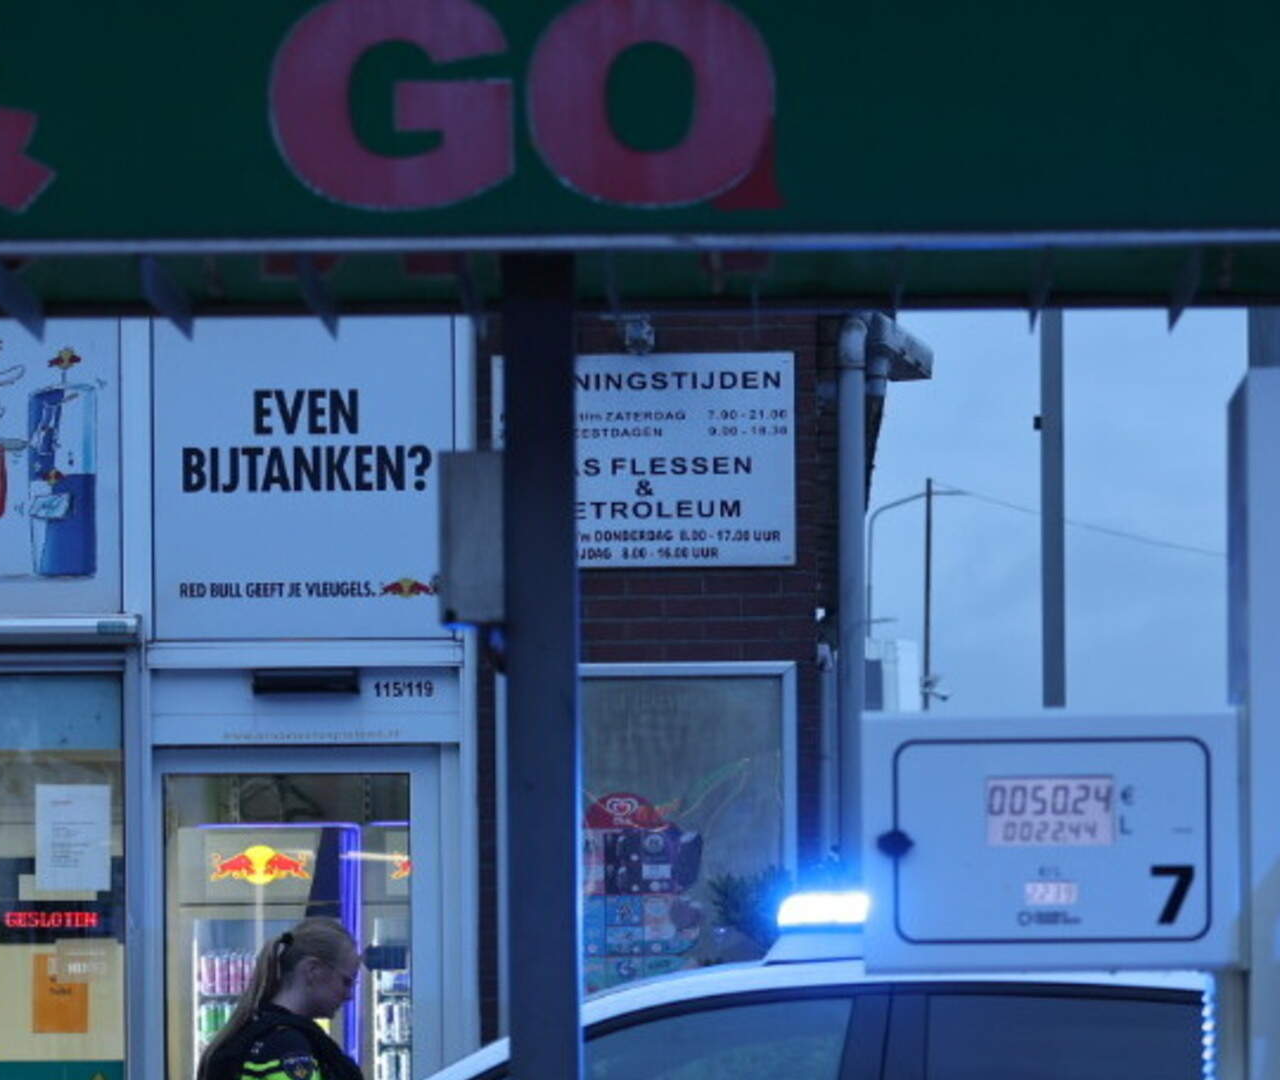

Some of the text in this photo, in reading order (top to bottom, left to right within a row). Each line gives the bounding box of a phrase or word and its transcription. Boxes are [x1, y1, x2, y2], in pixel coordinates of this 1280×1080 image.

[268, 0, 780, 211] GO
[575, 370, 781, 391] NINGSTIJDEN
[253, 388, 359, 435] EVEN
[575, 427, 663, 439] ESTDAGEN
[182, 444, 432, 493] BIJTANKEN?
[611, 456, 753, 476] FLESSEN
[635, 479, 653, 497] &
[575, 499, 742, 519] ETROLEUM
[753, 529, 781, 542] UUR
[692, 546, 719, 560] UUR
[179, 580, 375, 599] RED BULL GEEFT JE VLEUGELS.
[1150, 864, 1196, 926] 7
